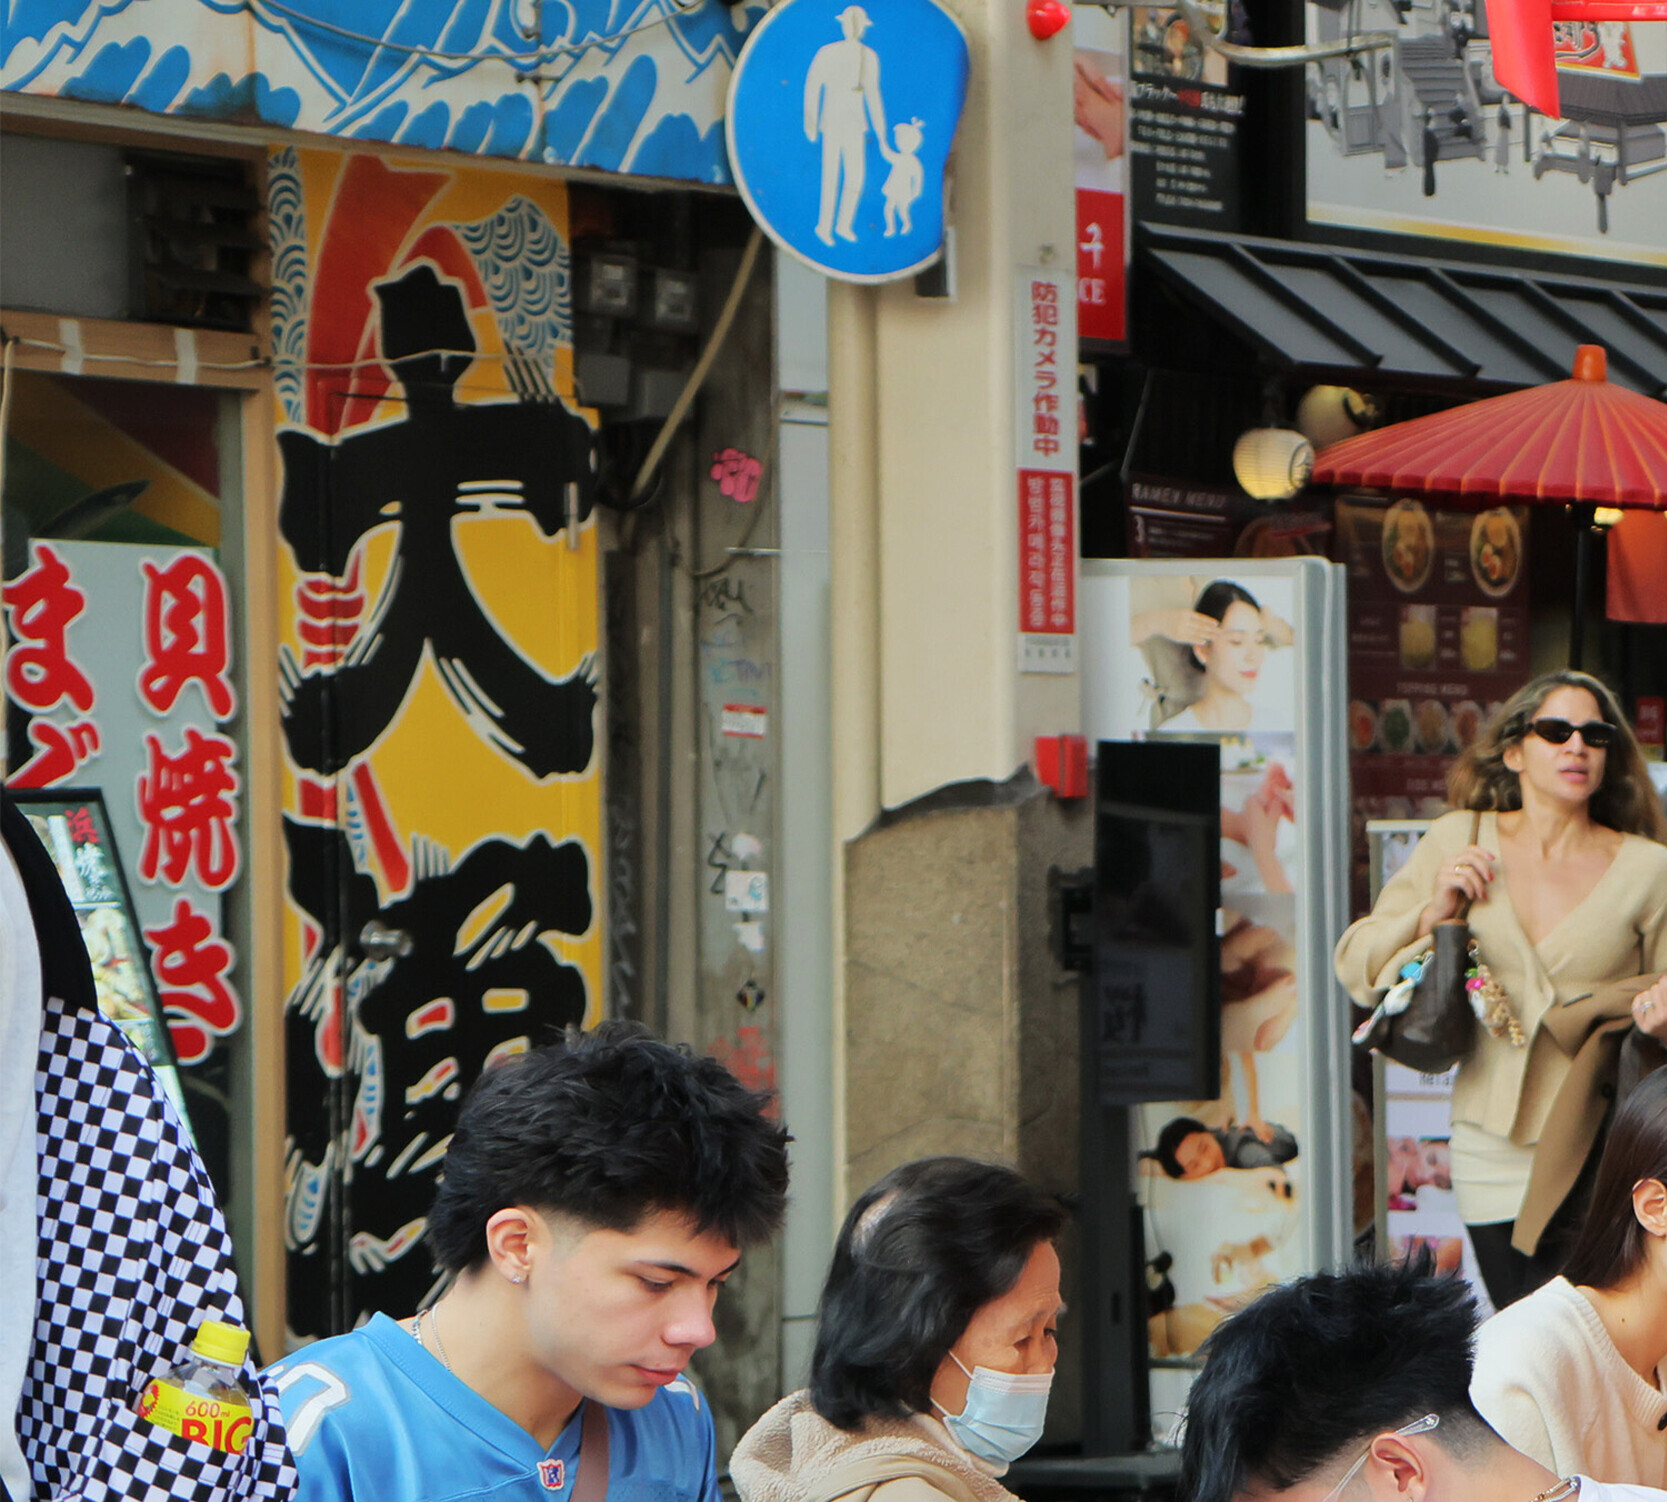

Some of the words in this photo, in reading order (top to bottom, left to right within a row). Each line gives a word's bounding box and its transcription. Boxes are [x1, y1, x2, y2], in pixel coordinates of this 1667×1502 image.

[1031, 281, 1060, 457] 防犯カメラ作動中
[138, 552, 242, 1065] 貝焼き
[181, 1416, 252, 1456] BIG
